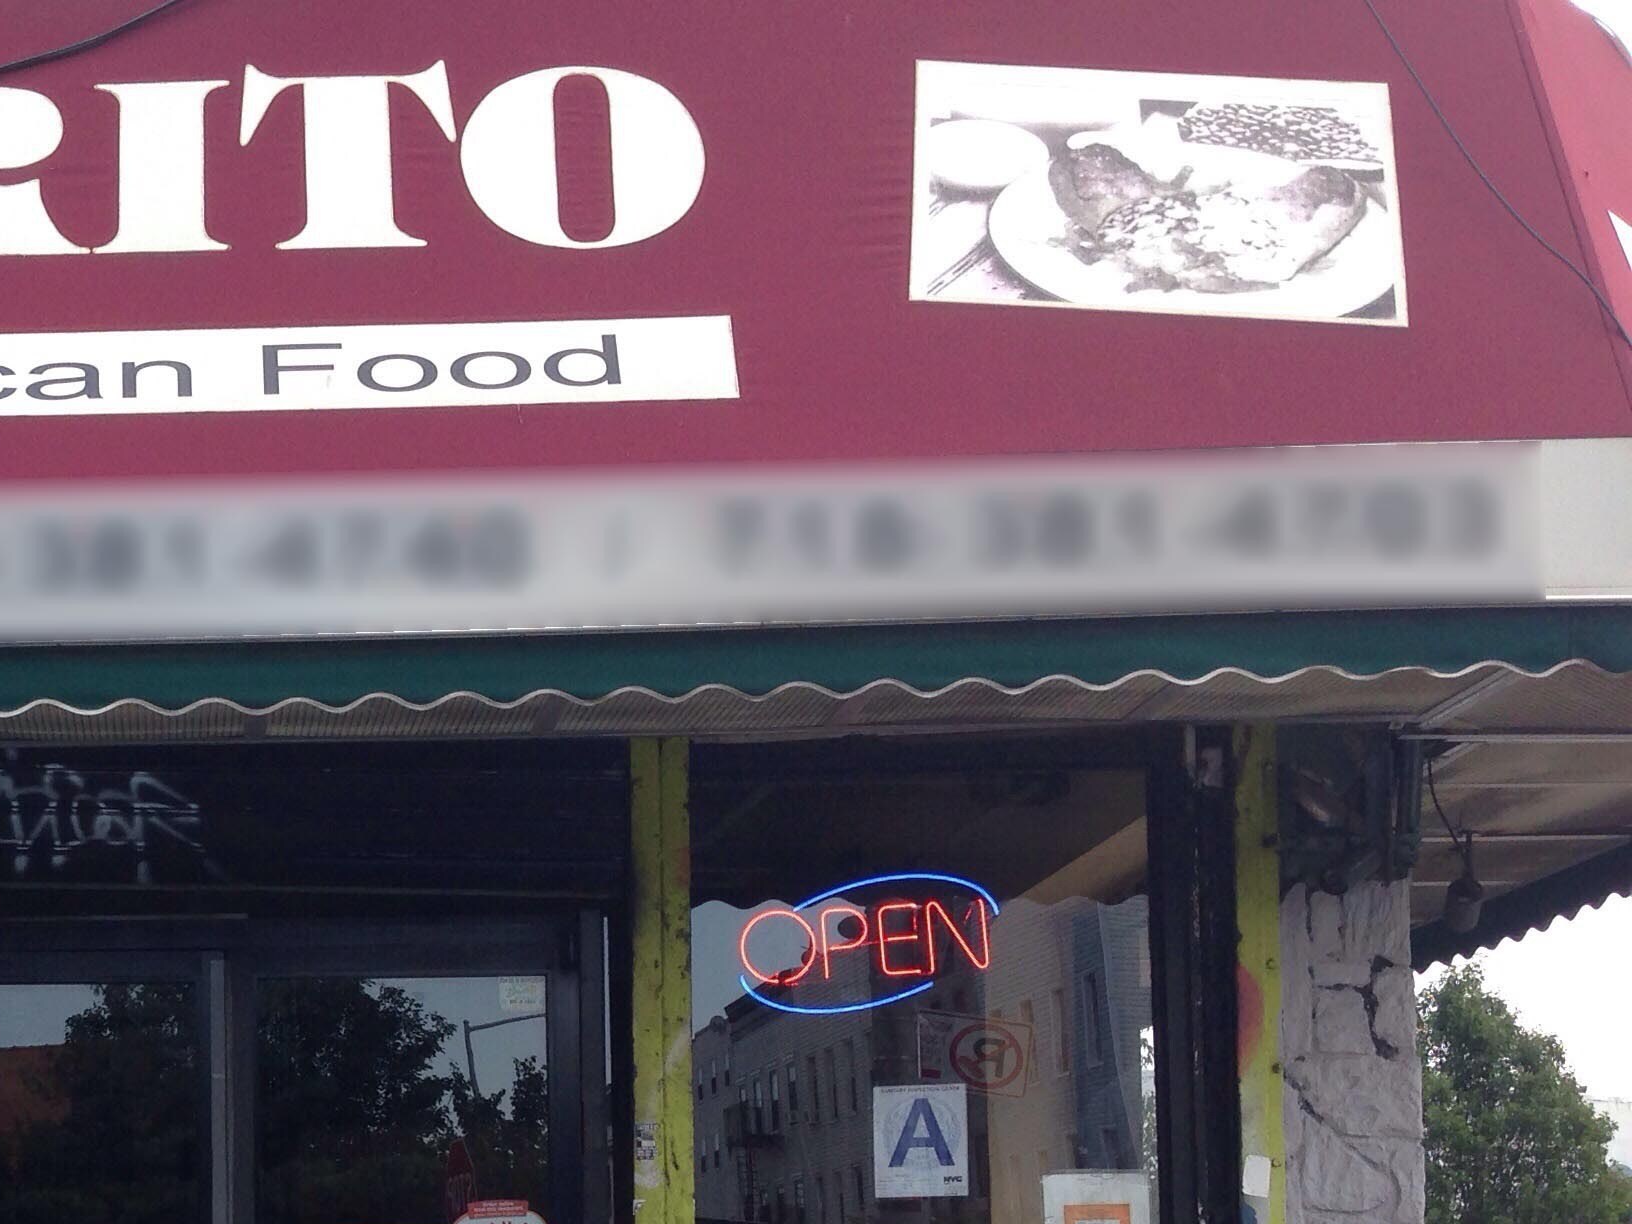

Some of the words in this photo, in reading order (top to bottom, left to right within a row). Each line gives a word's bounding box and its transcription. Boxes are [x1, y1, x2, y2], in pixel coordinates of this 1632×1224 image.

[262, 333, 623, 396] Food
[740, 899, 990, 983] OPEN
[888, 1098, 955, 1168] A
